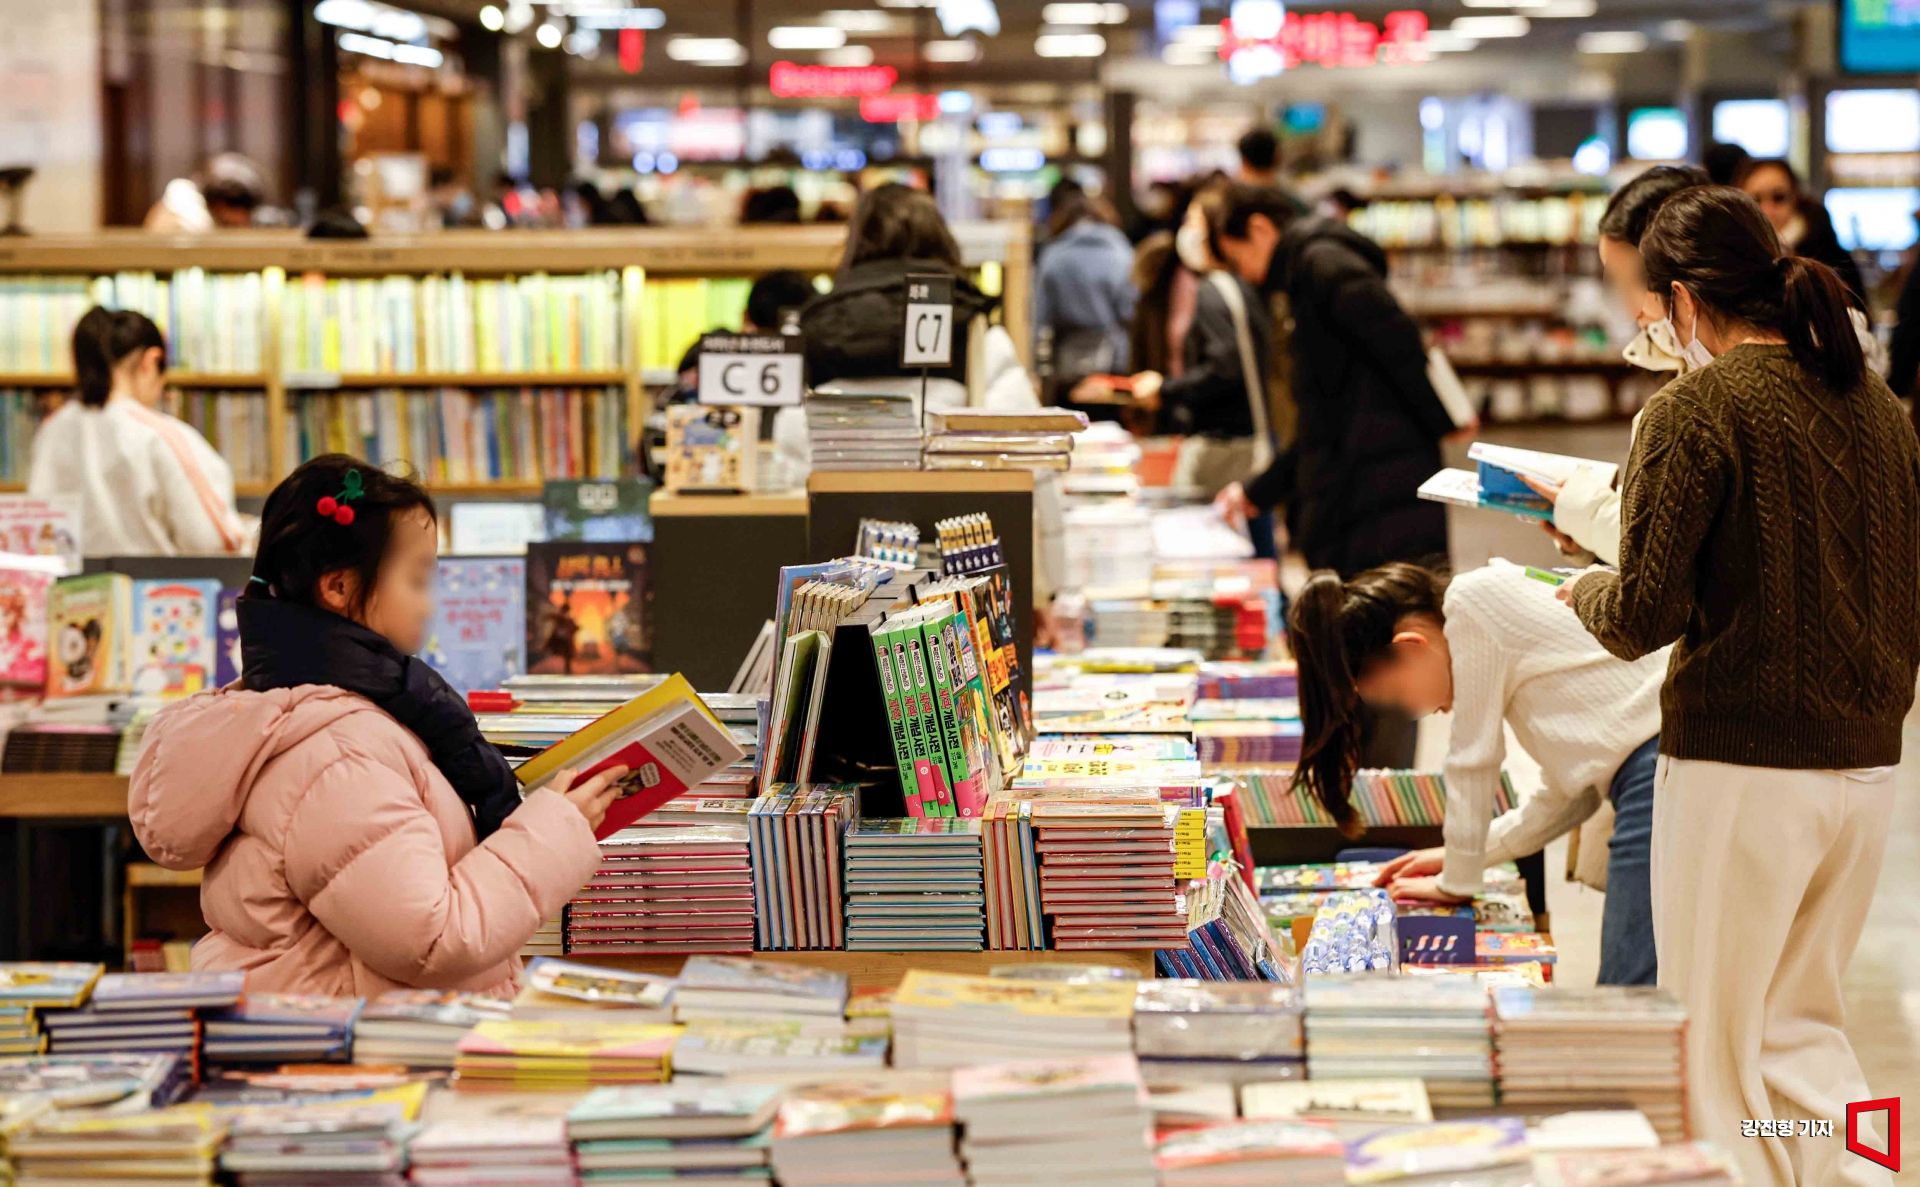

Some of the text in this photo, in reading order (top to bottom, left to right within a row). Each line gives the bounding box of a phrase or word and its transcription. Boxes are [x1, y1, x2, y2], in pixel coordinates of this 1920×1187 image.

[915, 313, 942, 353] C7
[888, 698, 910, 761] 과학 개념 사전
[904, 695, 926, 757] 과학 개념 사전
[919, 692, 941, 753] 과학 개념 사전
[939, 687, 960, 750] 과학 개념 사전
